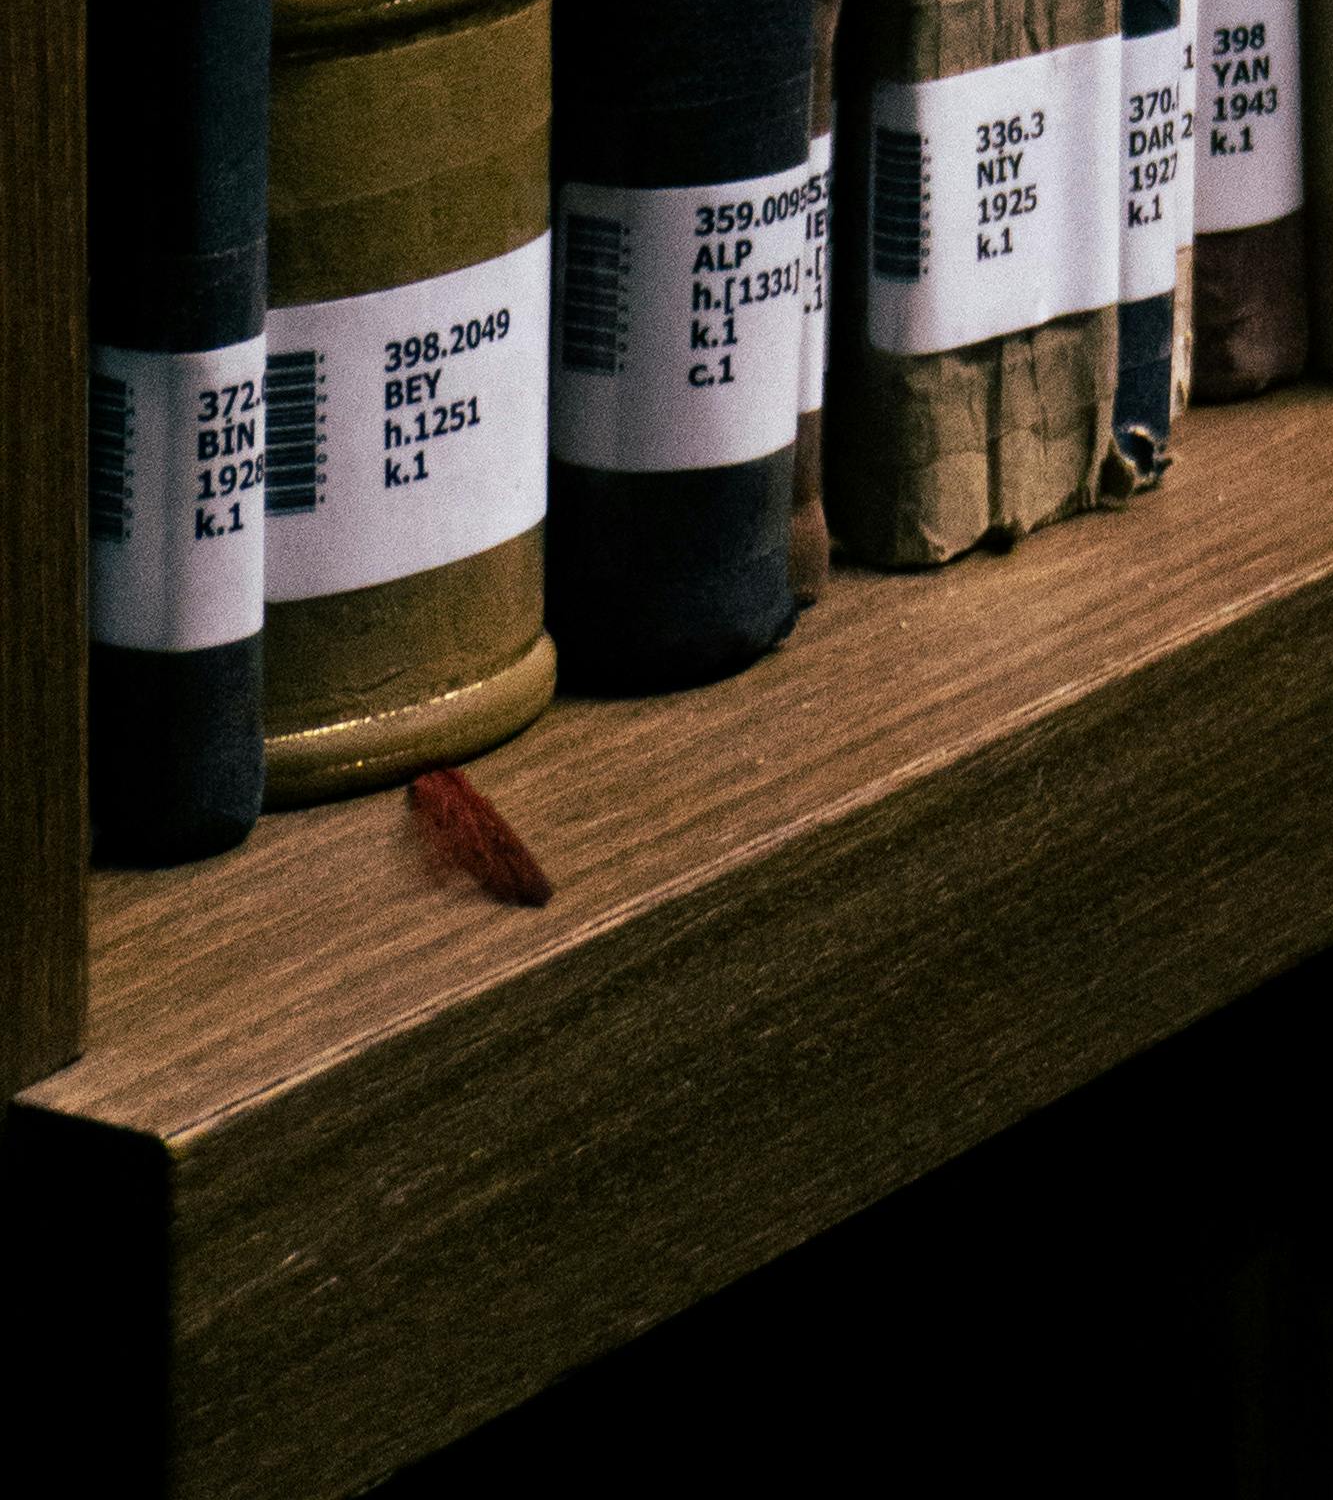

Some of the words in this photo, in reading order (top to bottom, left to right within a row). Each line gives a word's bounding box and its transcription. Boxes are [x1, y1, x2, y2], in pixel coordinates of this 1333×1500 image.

[1212, 23, 1266, 57] 398
[1210, 55, 1271, 88] YAN
[1212, 84, 1279, 123] 1943
[975, 110, 1046, 154] 336.3
[1128, 120, 1175, 159] DAR
[1210, 125, 1254, 158] k.1
[976, 146, 1025, 190] NİY
[977, 183, 1039, 226] 1925
[1127, 194, 1163, 229] k.1
[692, 239, 754, 274] ALP
[975, 226, 1014, 263] k.1
[691, 257, 802, 316] h.[1331]
[384, 307, 512, 373] 398.2049
[690, 317, 739, 351] k.1
[384, 368, 443, 411] BEY
[688, 355, 735, 389] c.1
[197, 416, 256, 462] BİN
[384, 396, 481, 450] h.1251
[384, 450, 429, 489] k.1
[194, 501, 245, 541] k.1
